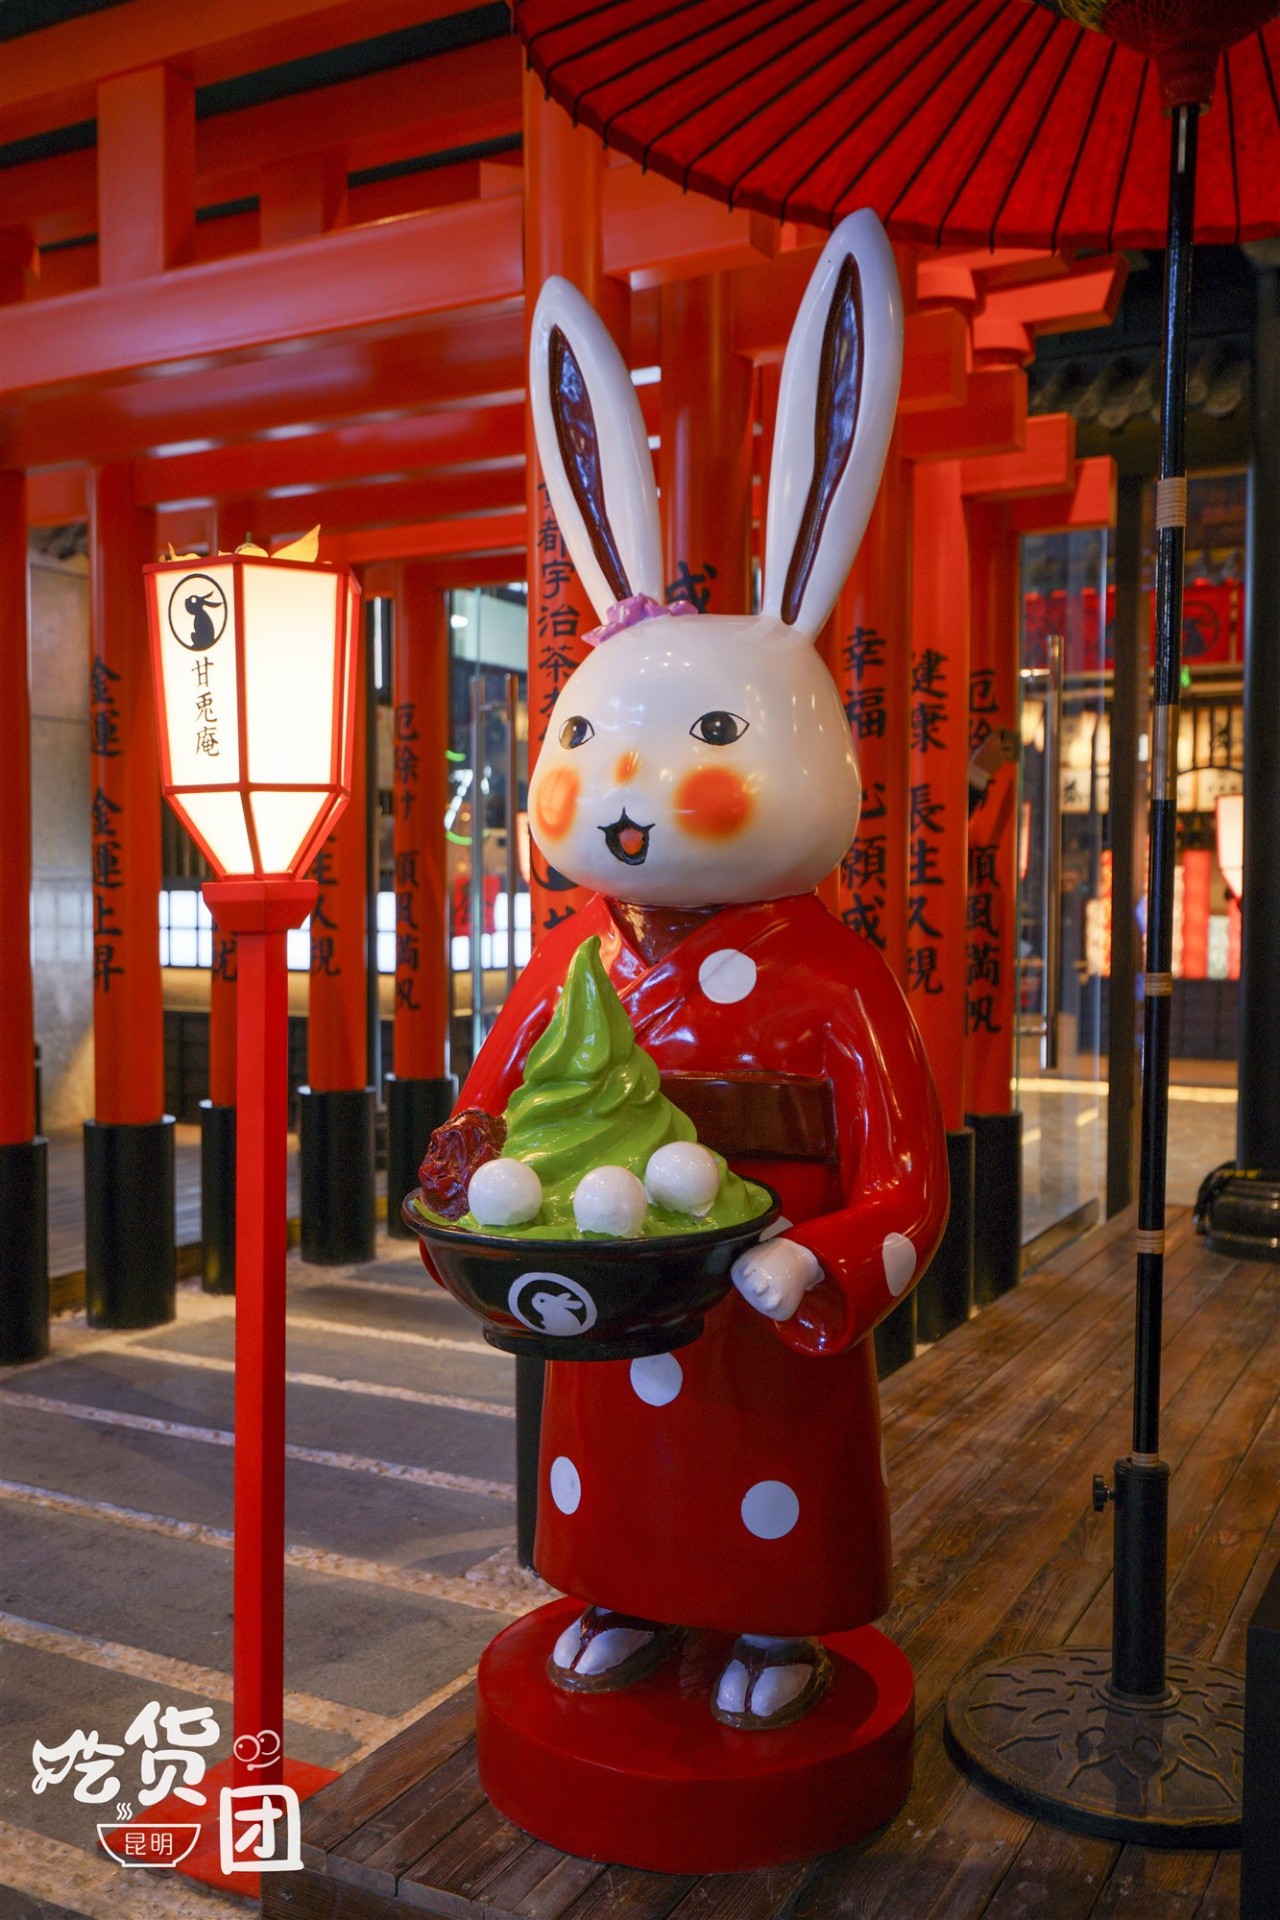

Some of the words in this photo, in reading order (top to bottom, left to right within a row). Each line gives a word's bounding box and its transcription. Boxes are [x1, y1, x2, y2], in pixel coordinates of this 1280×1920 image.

[537, 481, 581, 742] 都宇治茶
[843, 627, 887, 739] 幸福
